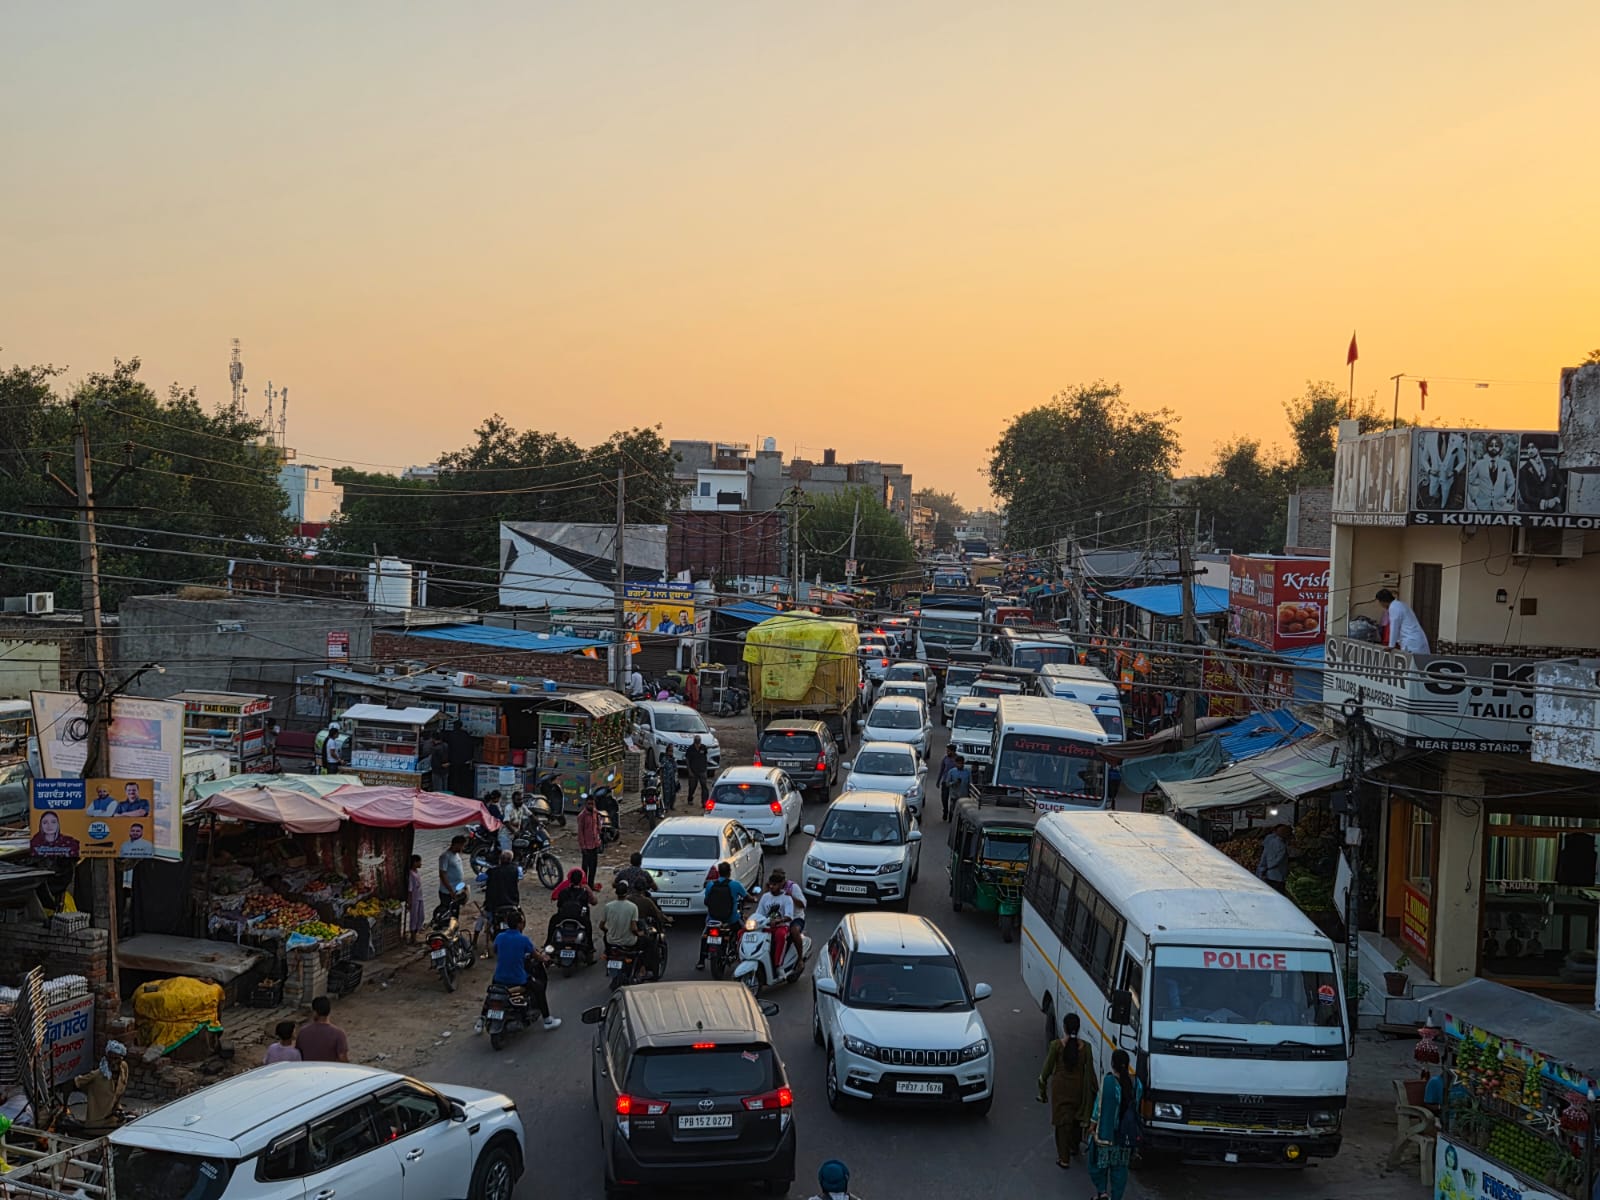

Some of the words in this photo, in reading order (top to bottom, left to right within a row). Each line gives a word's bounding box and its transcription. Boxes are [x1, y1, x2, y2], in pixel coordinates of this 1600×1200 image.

[1415, 513, 1435, 524] S.
[1443, 514, 1522, 525] KUMAR
[1416, 740, 1448, 750] NEAR
[1452, 741, 1476, 751] BUS
[1203, 951, 1287, 971] POLICE
